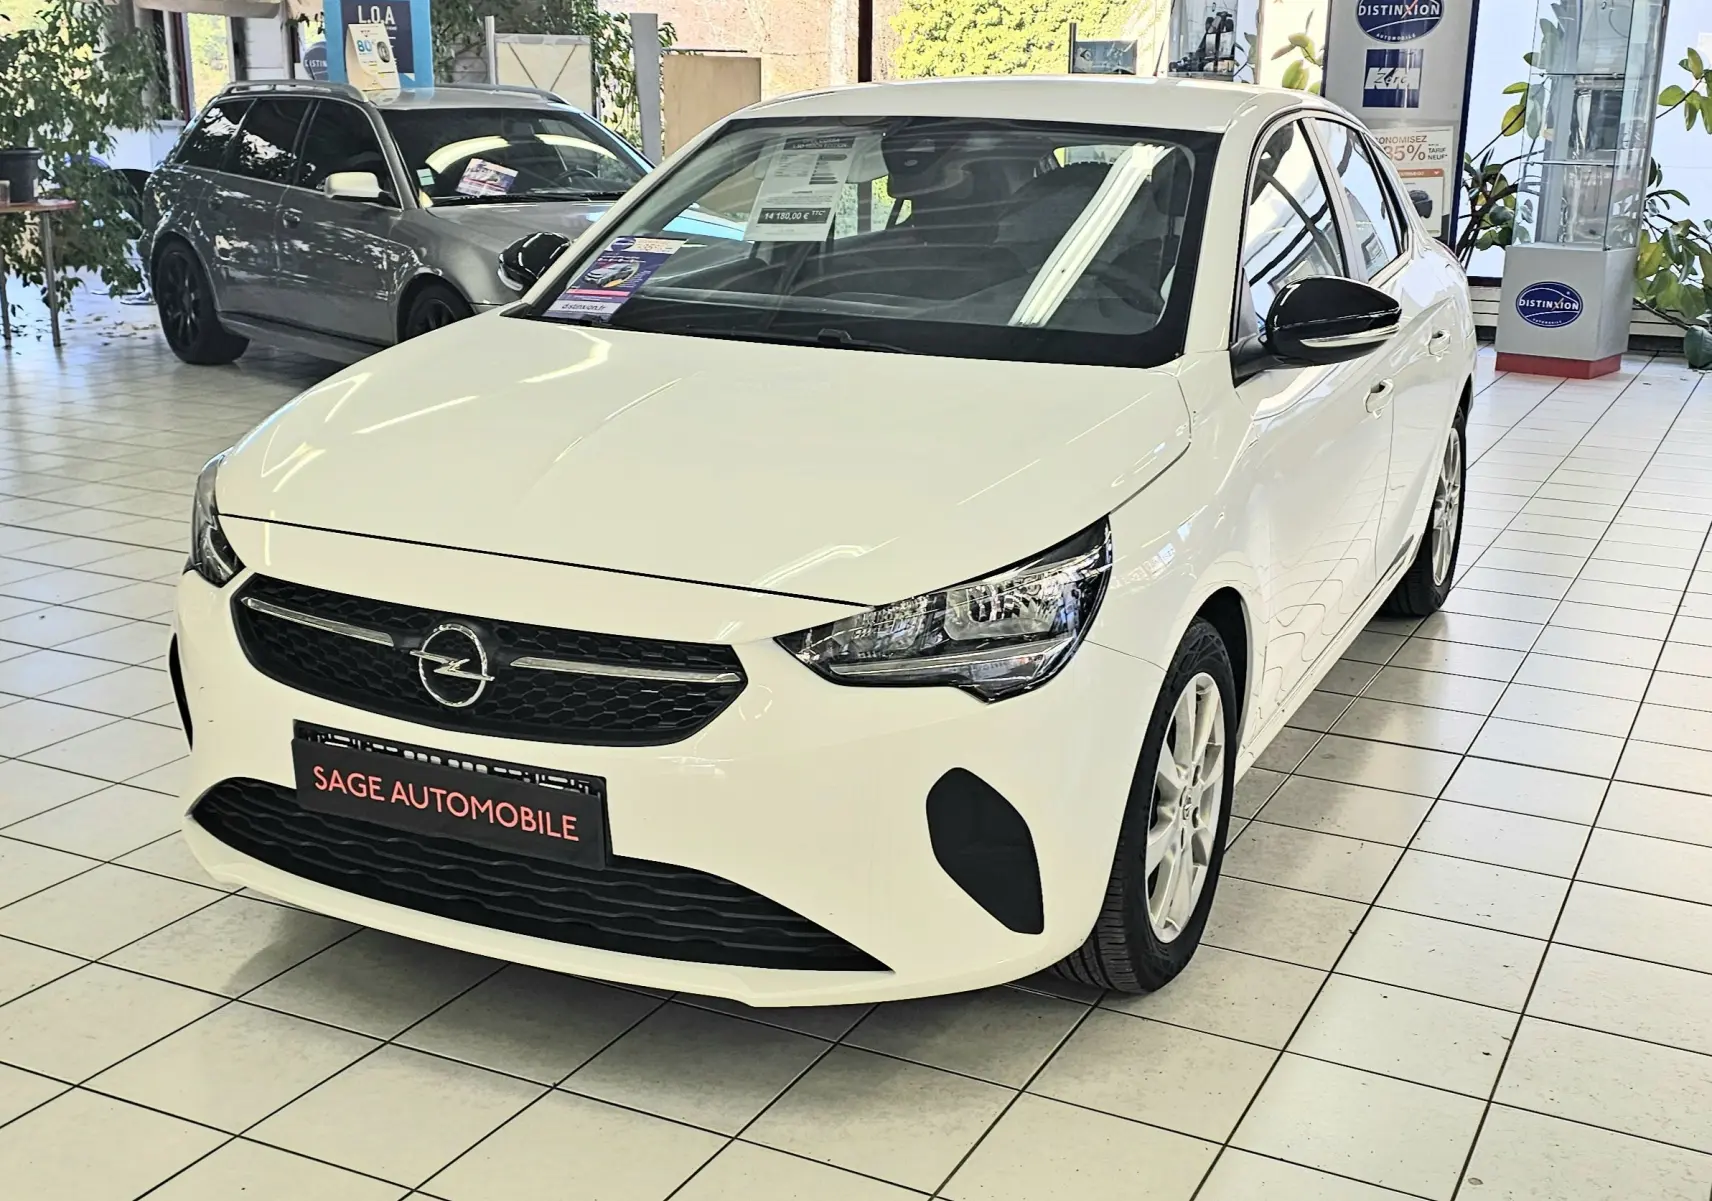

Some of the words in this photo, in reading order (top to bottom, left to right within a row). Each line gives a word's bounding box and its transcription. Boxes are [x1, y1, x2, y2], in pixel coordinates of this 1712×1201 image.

[1358, 2, 1440, 17] DISTINXION
[1376, 33, 1416, 41] AUTOMOBILE
[1375, 135, 1427, 145] ONOMISEZ
[1519, 298, 1579, 311] DISTINXION
[312, 765, 385, 801] SAGE
[391, 781, 579, 842] AUTOMOBILE
